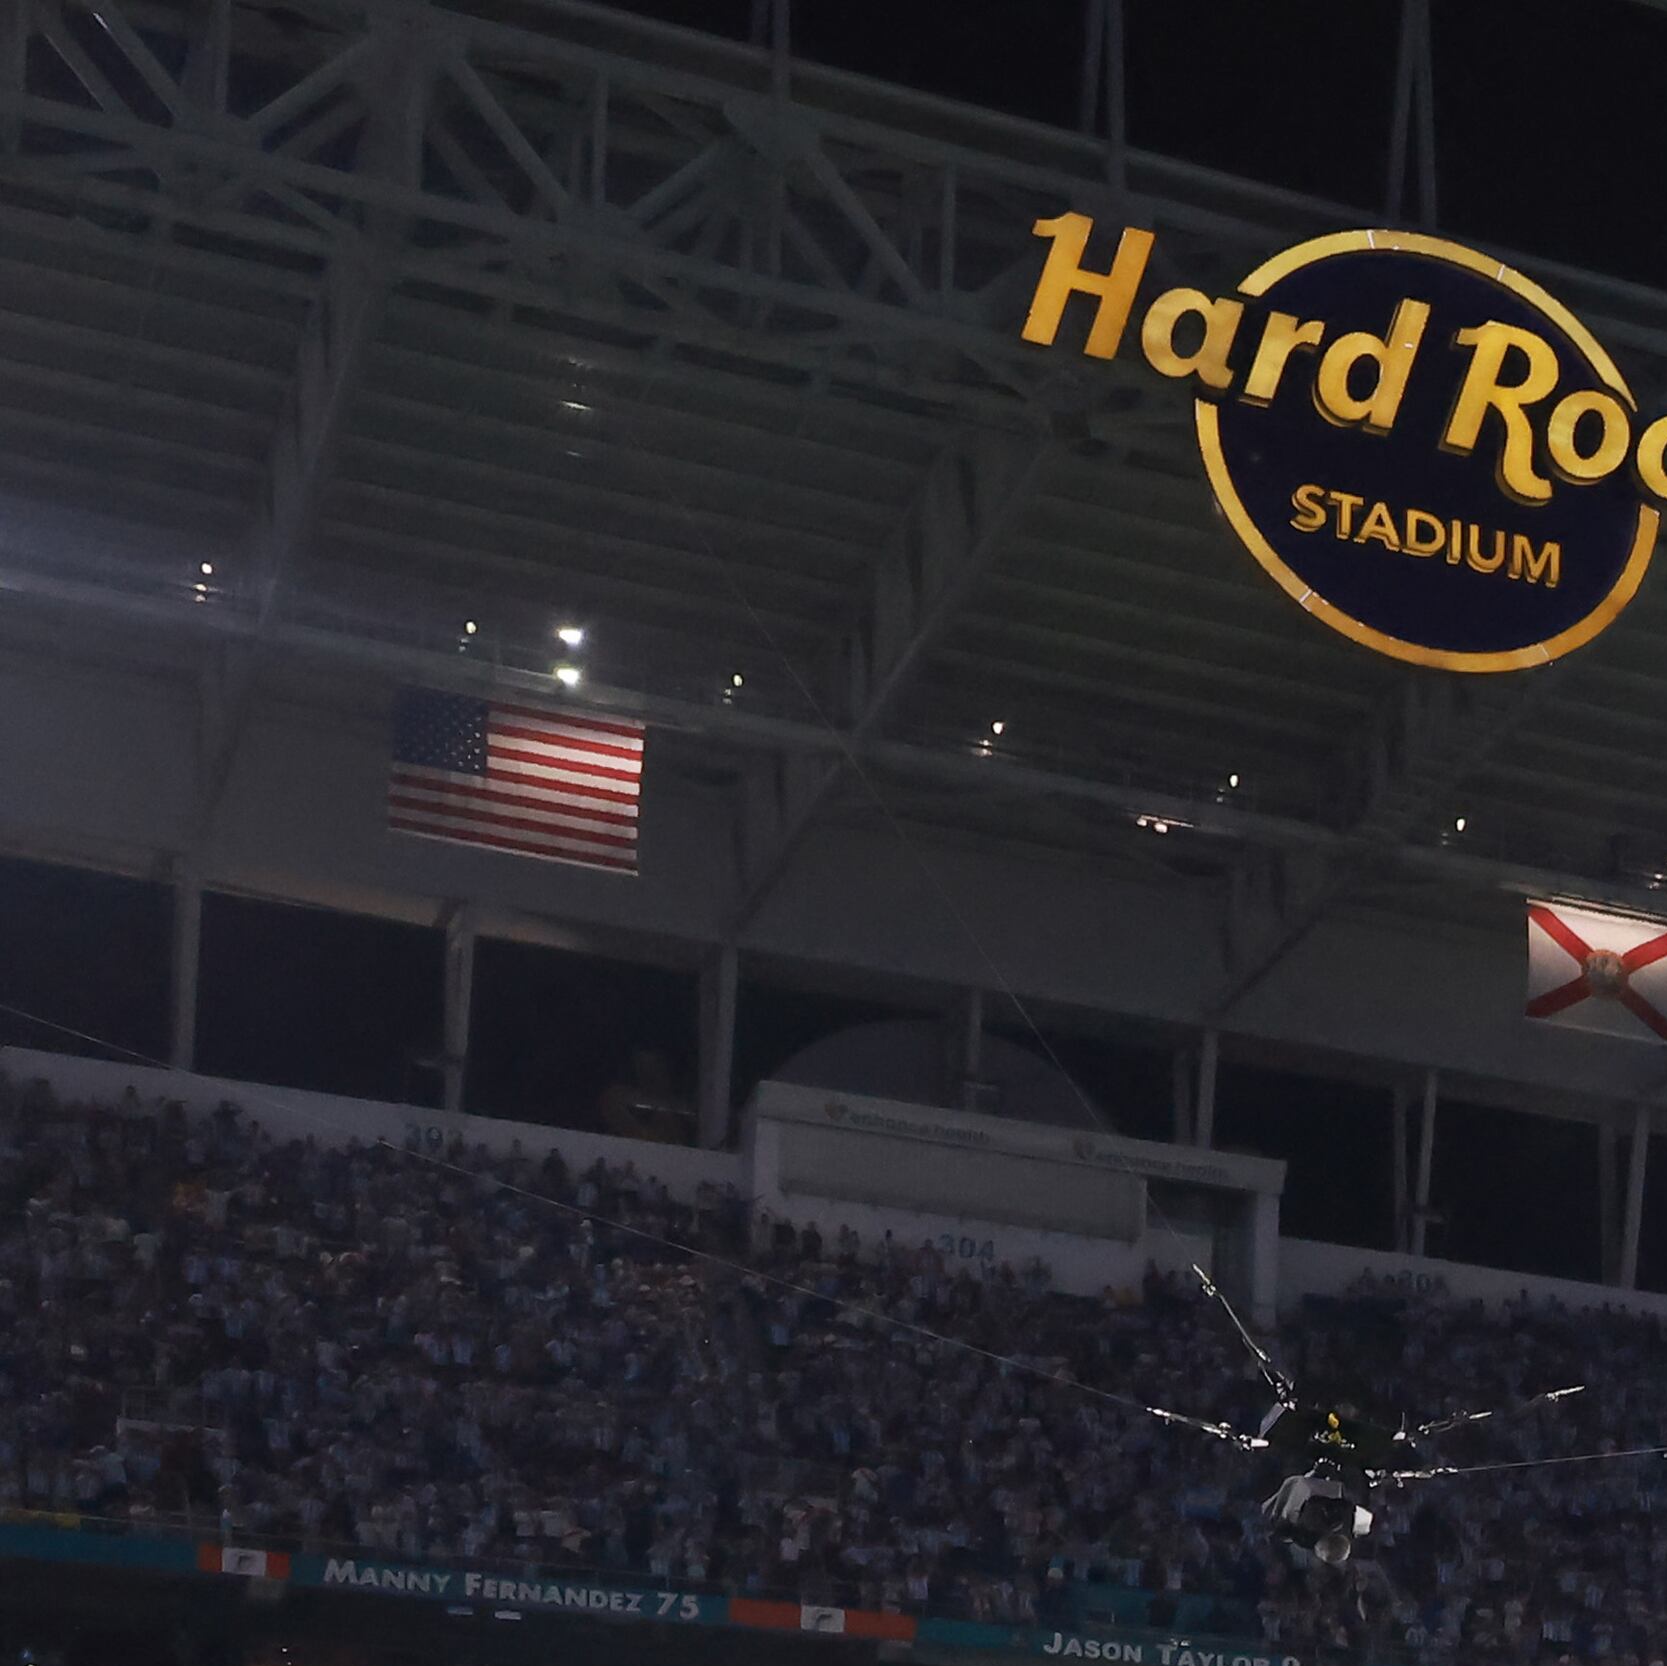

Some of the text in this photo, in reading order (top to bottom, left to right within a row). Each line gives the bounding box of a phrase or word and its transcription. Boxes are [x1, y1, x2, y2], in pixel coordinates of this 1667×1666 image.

[1020, 210, 1431, 434] Hard
[1290, 482, 1563, 589] STADIUM
[324, 1558, 700, 1621] MANNY FERNANDEZ 75
[1043, 1632, 1143, 1664] JASON
